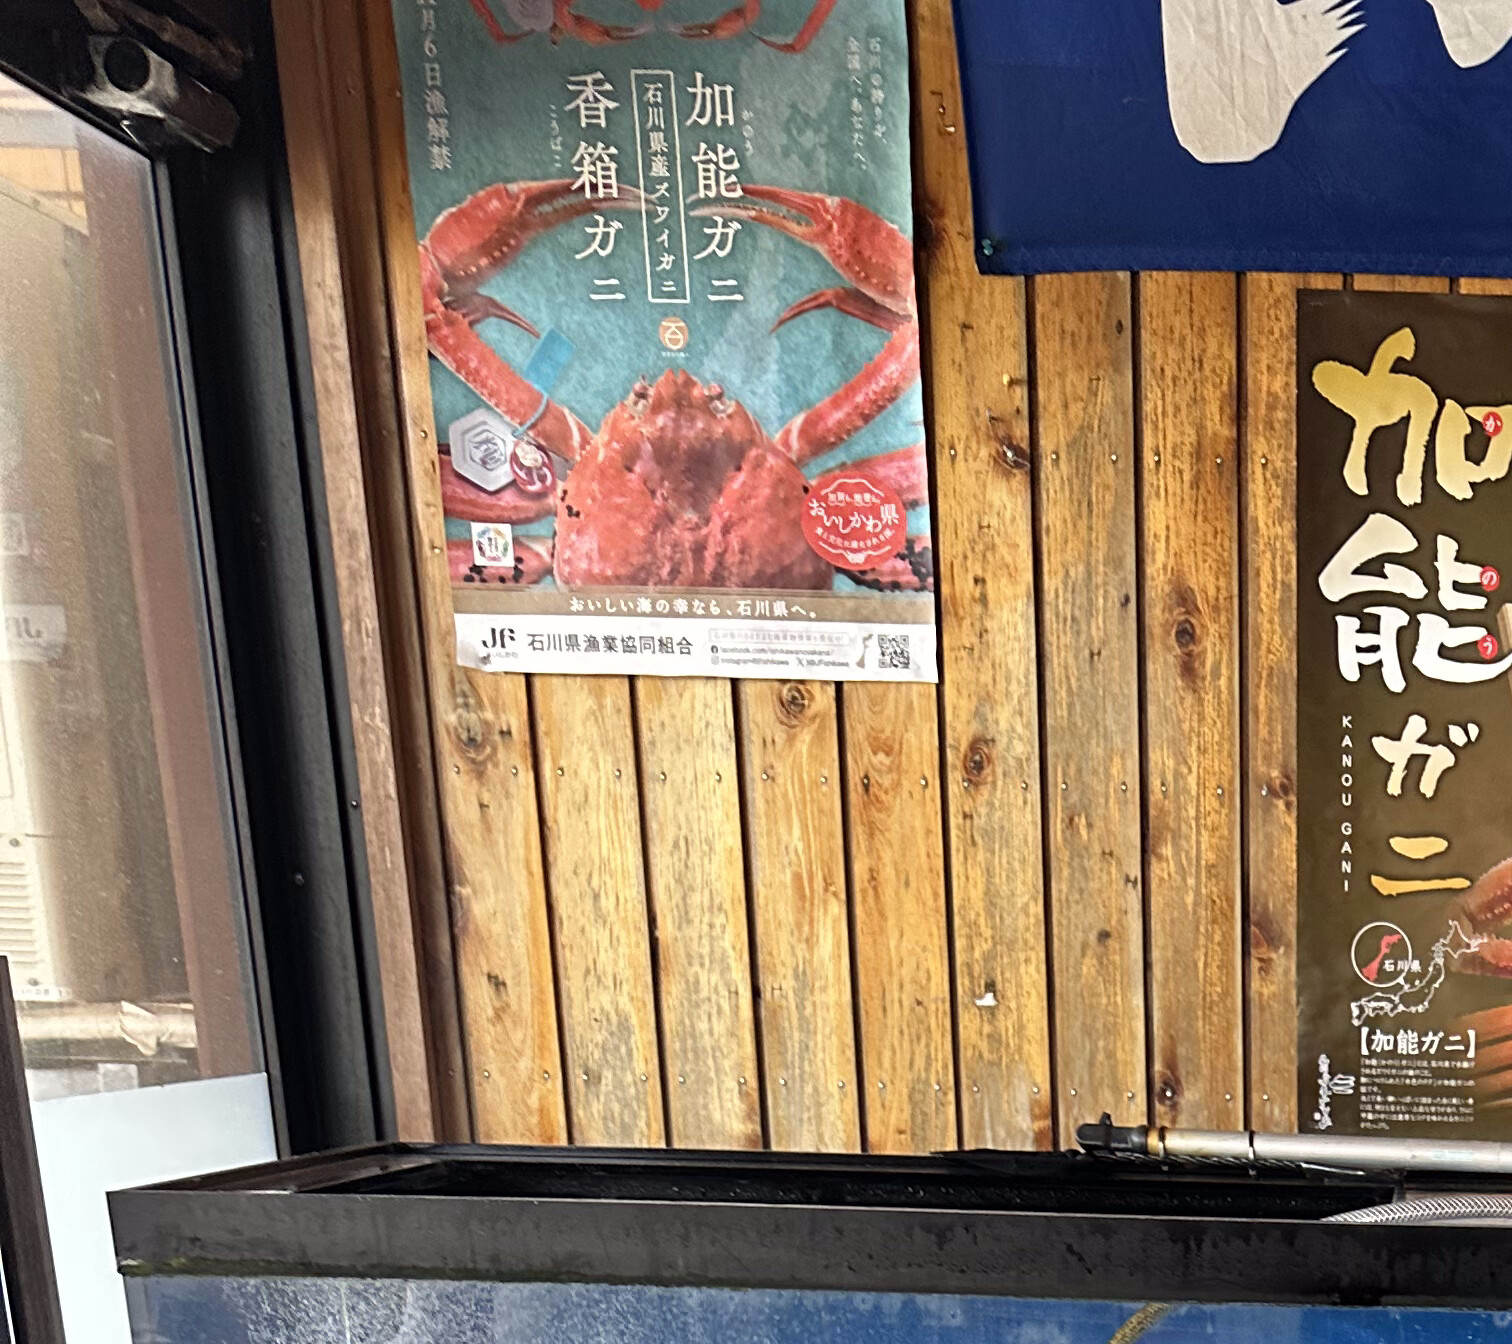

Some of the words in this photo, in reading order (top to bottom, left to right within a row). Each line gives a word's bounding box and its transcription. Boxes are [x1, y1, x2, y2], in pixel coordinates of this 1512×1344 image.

[417, 0, 452, 170] 月6日漁解禁
[564, 71, 626, 300] 香箱ガニ
[685, 71, 744, 300] 加能ガニ
[526, 633, 693, 656] 石川県漁業協同組合
[1341, 704, 1354, 806] KANOU
[1340, 822, 1353, 893] GANI
